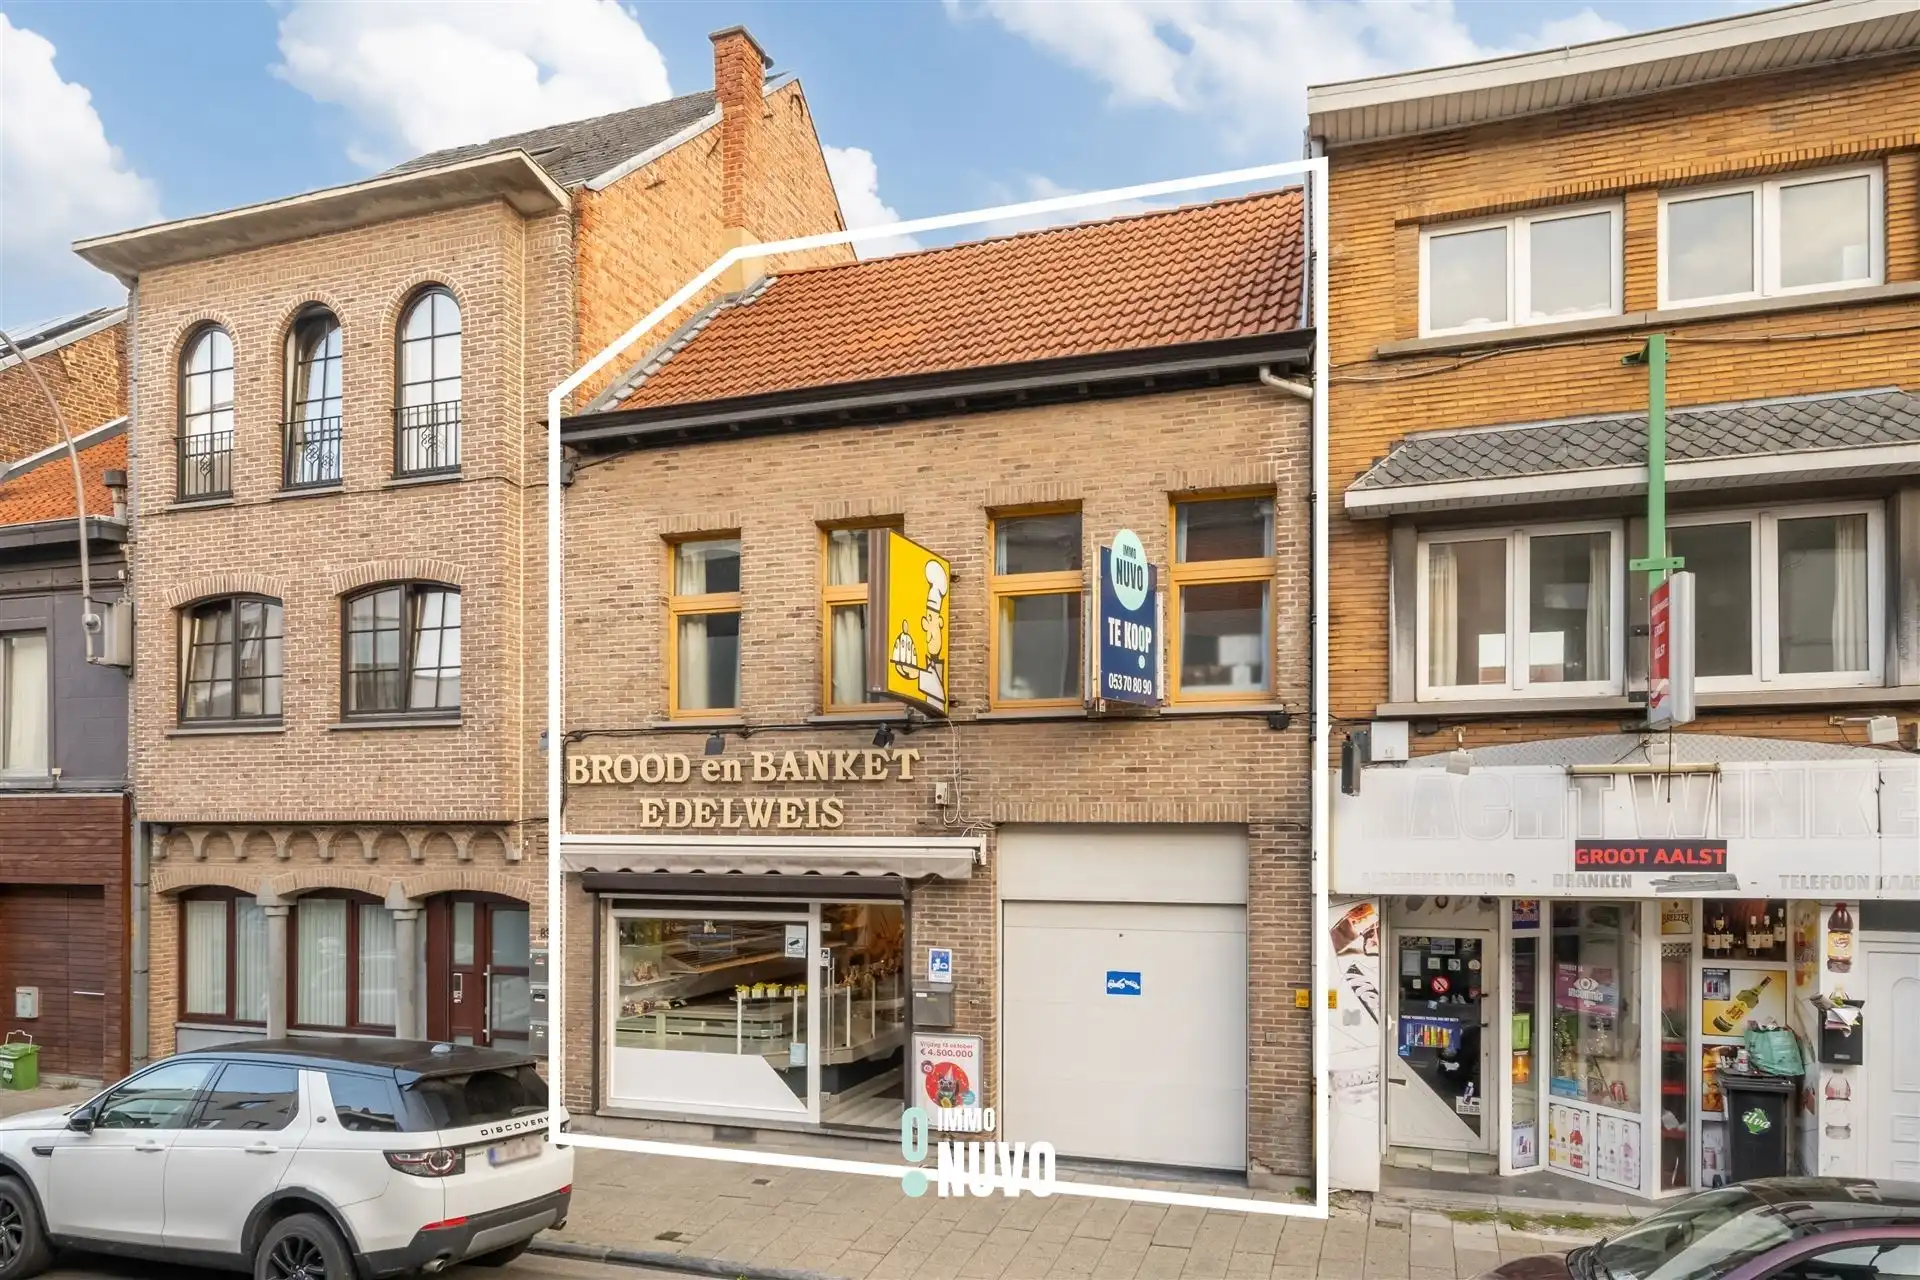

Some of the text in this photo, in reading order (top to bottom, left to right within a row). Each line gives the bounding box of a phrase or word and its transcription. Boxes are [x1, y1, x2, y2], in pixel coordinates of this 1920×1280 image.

[1122, 543, 1137, 559] IMMO
[1116, 557, 1143, 591] NUVO
[1108, 616, 1152, 653] TE KOOP
[1108, 672, 1152, 695] 053 70 80 90
[567, 749, 921, 784] BROOD en BANKET
[640, 797, 844, 828] EDELWEIS
[1575, 848, 1727, 865] GROOT AALST
[1443, 872, 1516, 888] VOEDING
[1552, 873, 1632, 888] DRANKEN
[1778, 874, 1870, 890] TELEFOON
[920, 1047, 974, 1058] € 4.500.000
[480, 1116, 549, 1136] DISCOVERY
